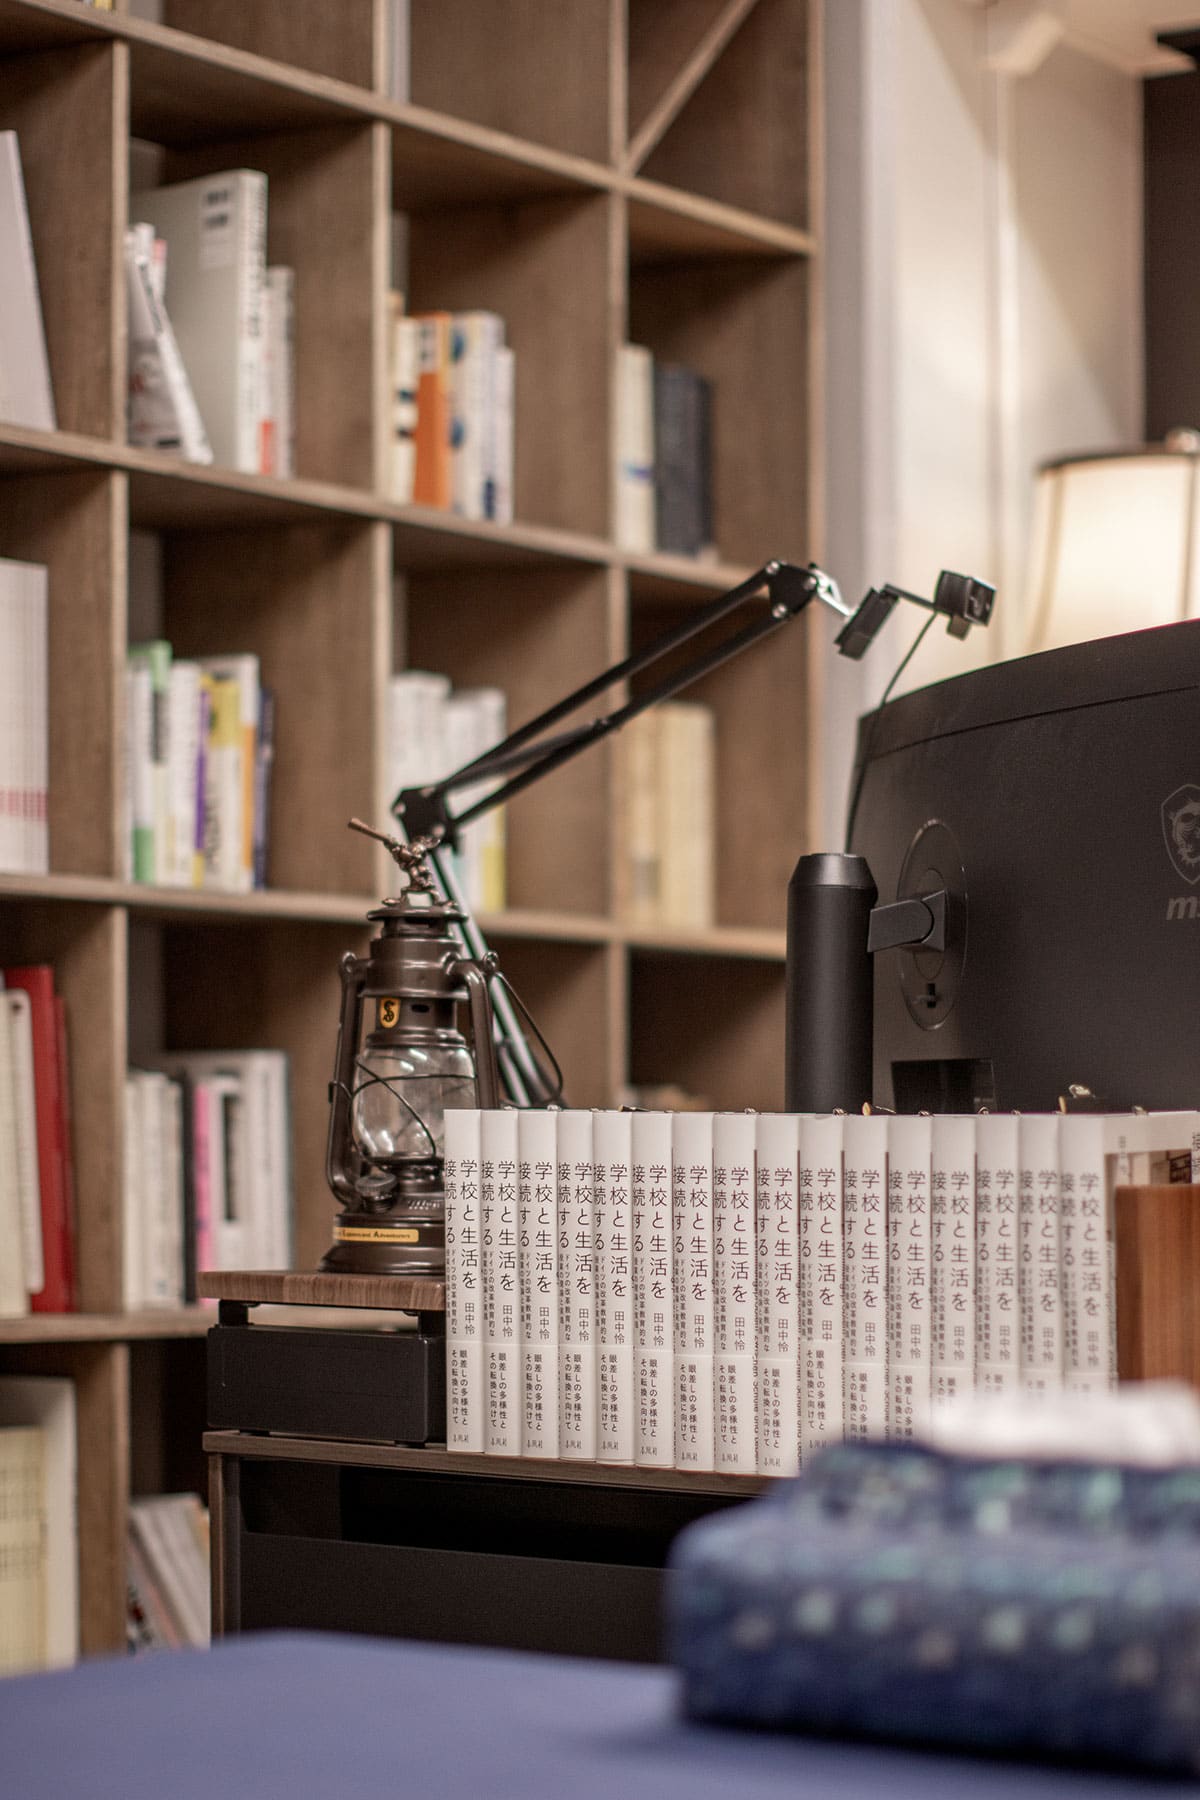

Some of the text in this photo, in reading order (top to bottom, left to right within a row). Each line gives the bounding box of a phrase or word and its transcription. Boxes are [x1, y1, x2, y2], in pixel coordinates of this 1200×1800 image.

[461, 1160, 478, 1289] 学校と生活を
[482, 1162, 494, 1245] 接続する
[498, 1161, 515, 1291] 学校と生活を
[520, 1162, 532, 1247] 接続する
[535, 1162, 552, 1293] 学校と生活を
[558, 1164, 570, 1248] 接続する
[575, 1163, 592, 1295] 学校と生活を
[594, 1165, 605, 1250] 接続する
[611, 1164, 628, 1297] 学校と生活を
[633, 1166, 645, 1252] 接続する
[650, 1165, 668, 1299] 学校と生活を
[673, 1167, 686, 1253] 接続する
[690, 1166, 708, 1300] 学校と生活を
[714, 1168, 727, 1254] 接続する
[730, 1167, 749, 1303] 学校と生活を
[774, 1168, 793, 1305] 学校と生活を
[800, 1169, 813, 1259] 接続する
[817, 1168, 836, 1306] 学校と生活を
[845, 1170, 858, 1259] 接続する
[861, 1169, 880, 1309] 学校と生活を
[889, 1171, 902, 1261] 接続する
[907, 1170, 926, 1310] 学校と生活を
[932, 1170, 946, 1262] 接続する
[950, 1170, 969, 1312] 学校と生活を
[995, 1169, 1014, 1311] 学校と生活を
[1020, 1171, 1034, 1262] 接続する
[1038, 1170, 1058, 1313] 学校と生活を
[1061, 1172, 1075, 1266] 接続する
[1079, 1172, 1101, 1317] 学校と生活を
[460, 1350, 468, 1425] 眼差しの多様性と
[490, 1352, 498, 1428] その転換に向けて
[499, 1353, 507, 1429] 眼差しの多様性と
[534, 1354, 542, 1431] 眼差しの多様性と
[564, 1354, 572, 1430] その転換に向けて
[574, 1354, 582, 1432] 眼差しの多様性と
[600, 1354, 608, 1430] その転換に向けて
[609, 1354, 618, 1432] 眼差しの多様性と
[640, 1358, 648, 1436] その転換に向けて
[650, 1359, 658, 1438] 眼差しの多様性と
[680, 1364, 688, 1442] その転換に向けて
[688, 1364, 696, 1444] 眼差しの多様性と
[728, 1365, 736, 1444] 眼差しの多様性と
[772, 1368, 780, 1448] 眼差しの多様性と
[806, 1350, 815, 1429] その転換に向けて
[816, 1350, 825, 1430] 眼差しの多様性と
